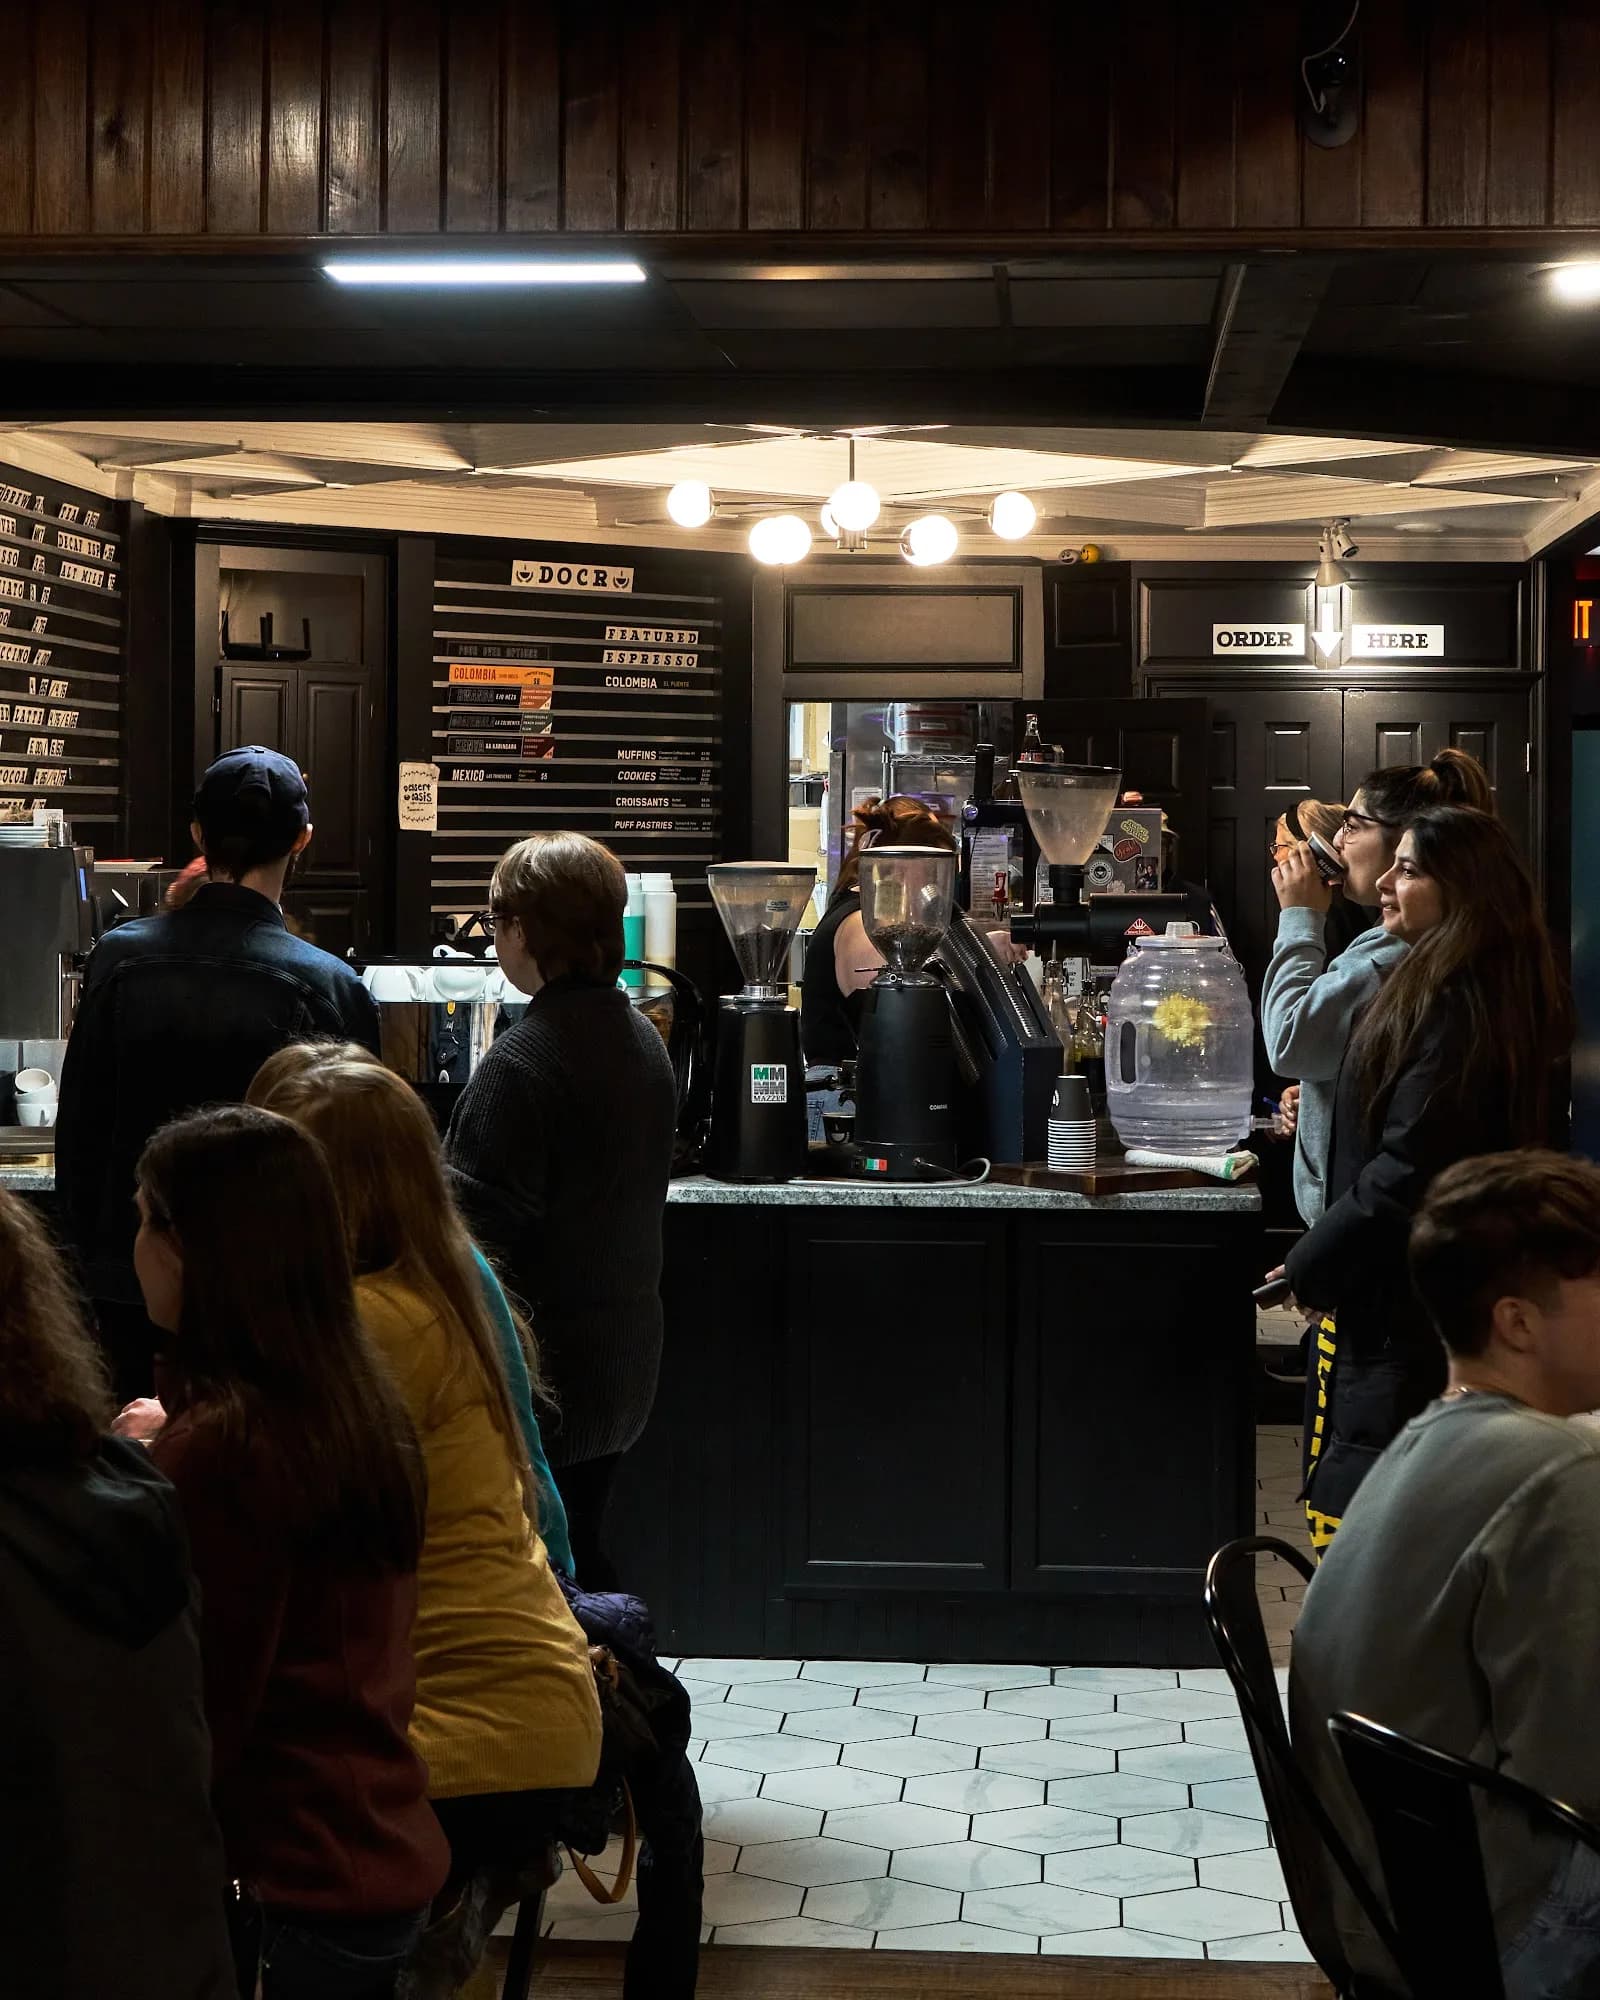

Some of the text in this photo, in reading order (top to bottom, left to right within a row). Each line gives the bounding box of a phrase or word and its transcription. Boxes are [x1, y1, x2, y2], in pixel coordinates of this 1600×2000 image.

[539, 566, 608, 587] DOCR
[608, 629, 696, 643] FEATURED
[1217, 632, 1428, 649] ORDER HERE
[606, 652, 695, 666] ESPRESSO
[454, 668, 496, 680] COLOMBIA
[605, 676, 658, 688] COLOMBIA
[617, 750, 656, 760] MUFFINS
[452, 769, 485, 782] MEXICO
[617, 771, 656, 782] COOKIES
[615, 798, 669, 807] CROISSANTS
[614, 821, 634, 830] PUFF
[635, 821, 673, 831] PASTRIES
